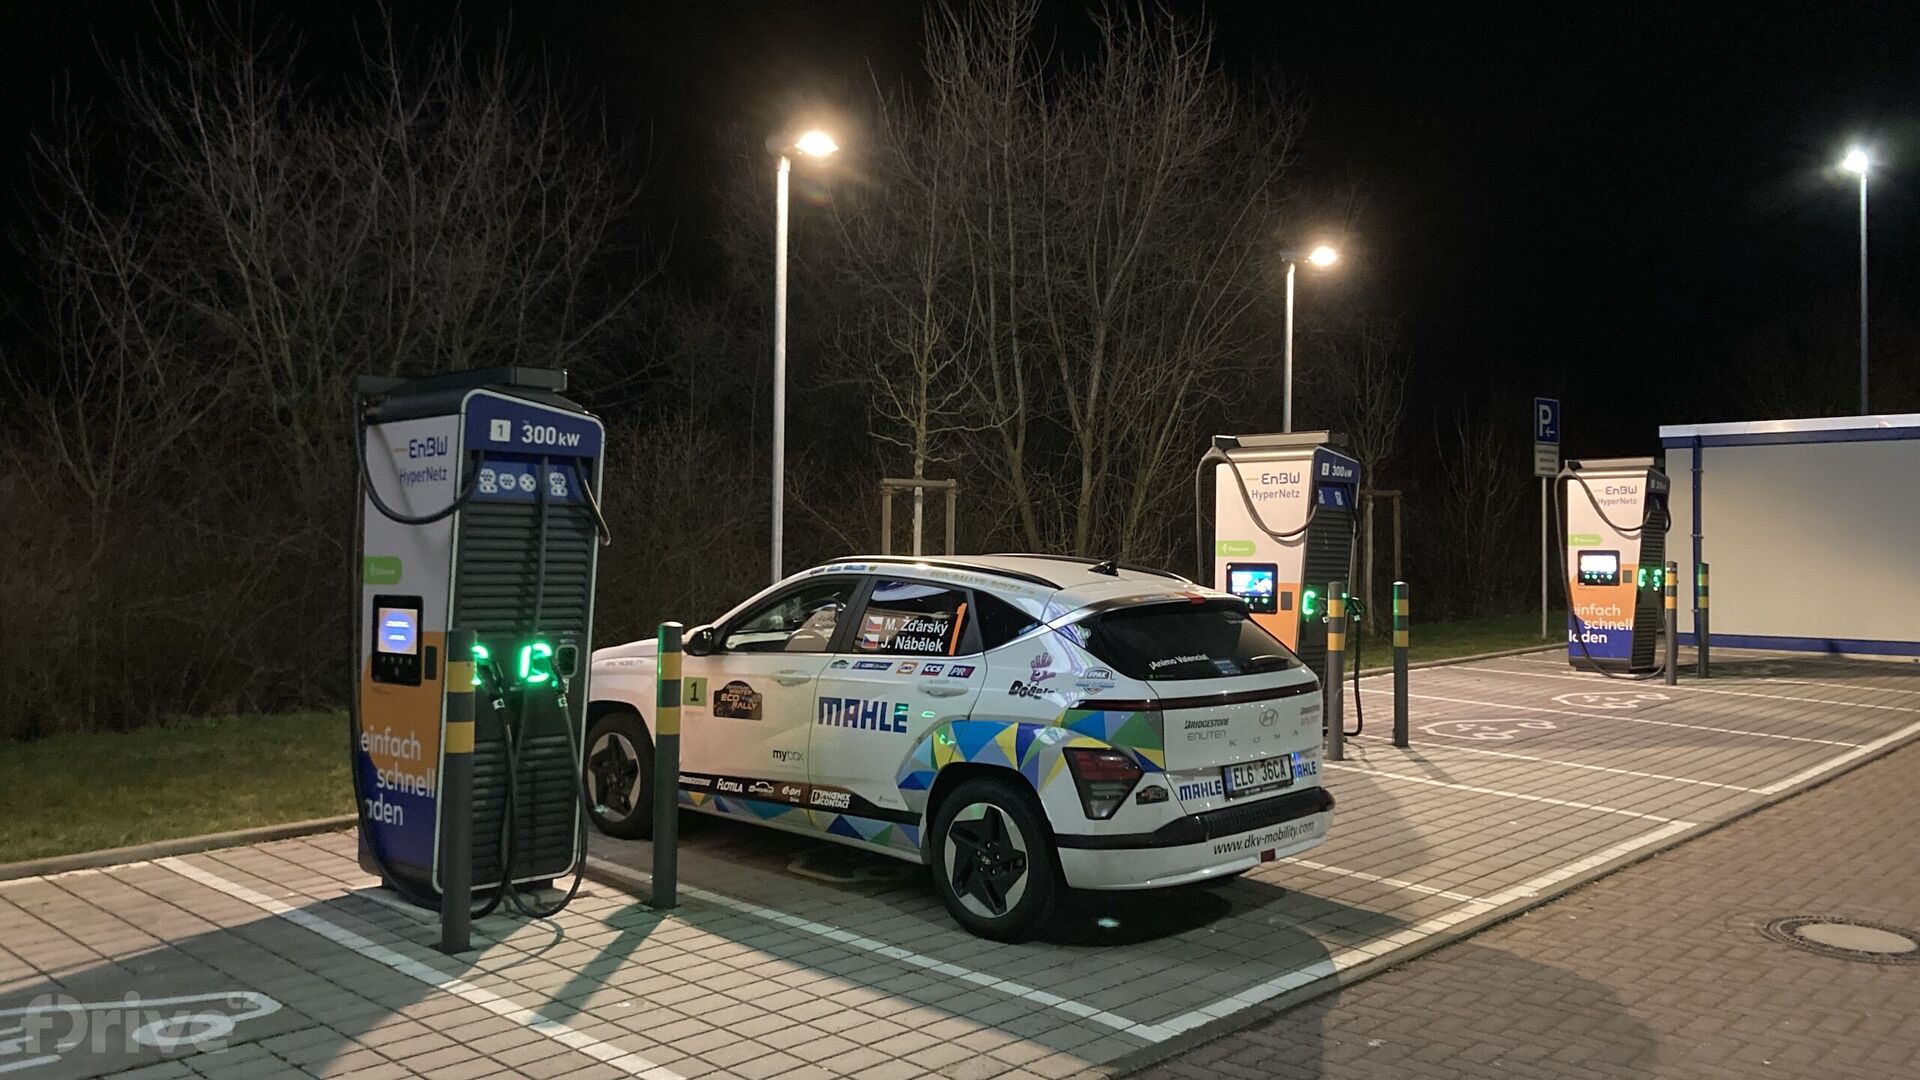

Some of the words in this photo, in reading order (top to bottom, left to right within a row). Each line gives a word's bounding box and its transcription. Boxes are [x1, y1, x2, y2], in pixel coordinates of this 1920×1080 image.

[1538, 404, 1552, 437] P
[497, 423, 504, 437] 1
[408, 436, 449, 459] EnBW
[400, 467, 447, 487] HyperNetz
[1261, 472, 1300, 485] EnBW
[1251, 489, 1300, 501] HyperNetz
[1605, 485, 1638, 495] EnBW
[1597, 498, 1638, 507] HyperNetz
[884, 618, 897, 631] M.
[900, 616, 949, 637] Žďárský
[948, 602, 968, 656] 1
[1584, 617, 1634, 631] schnell
[880, 636, 891, 649] J.
[894, 636, 944, 653] Nábělek
[924, 664, 943, 673] CCS
[690, 681, 699, 702] 1
[721, 693, 740, 702] ECO
[732, 701, 758, 712] RALLY
[818, 696, 909, 734] MAHLE
[1184, 718, 1230, 730] BRIDGESTONE
[361, 724, 422, 761] einfach
[376, 761, 436, 799] schnell
[1233, 765, 1255, 788] EL6
[1262, 759, 1287, 781] 36CA
[716, 778, 744, 793] FLOTILA
[1179, 780, 1222, 801] MAHLE
[364, 793, 404, 827] aden
[820, 798, 850, 809] CONTACT
[1213, 821, 1315, 855] www.dkv-mobility.com
